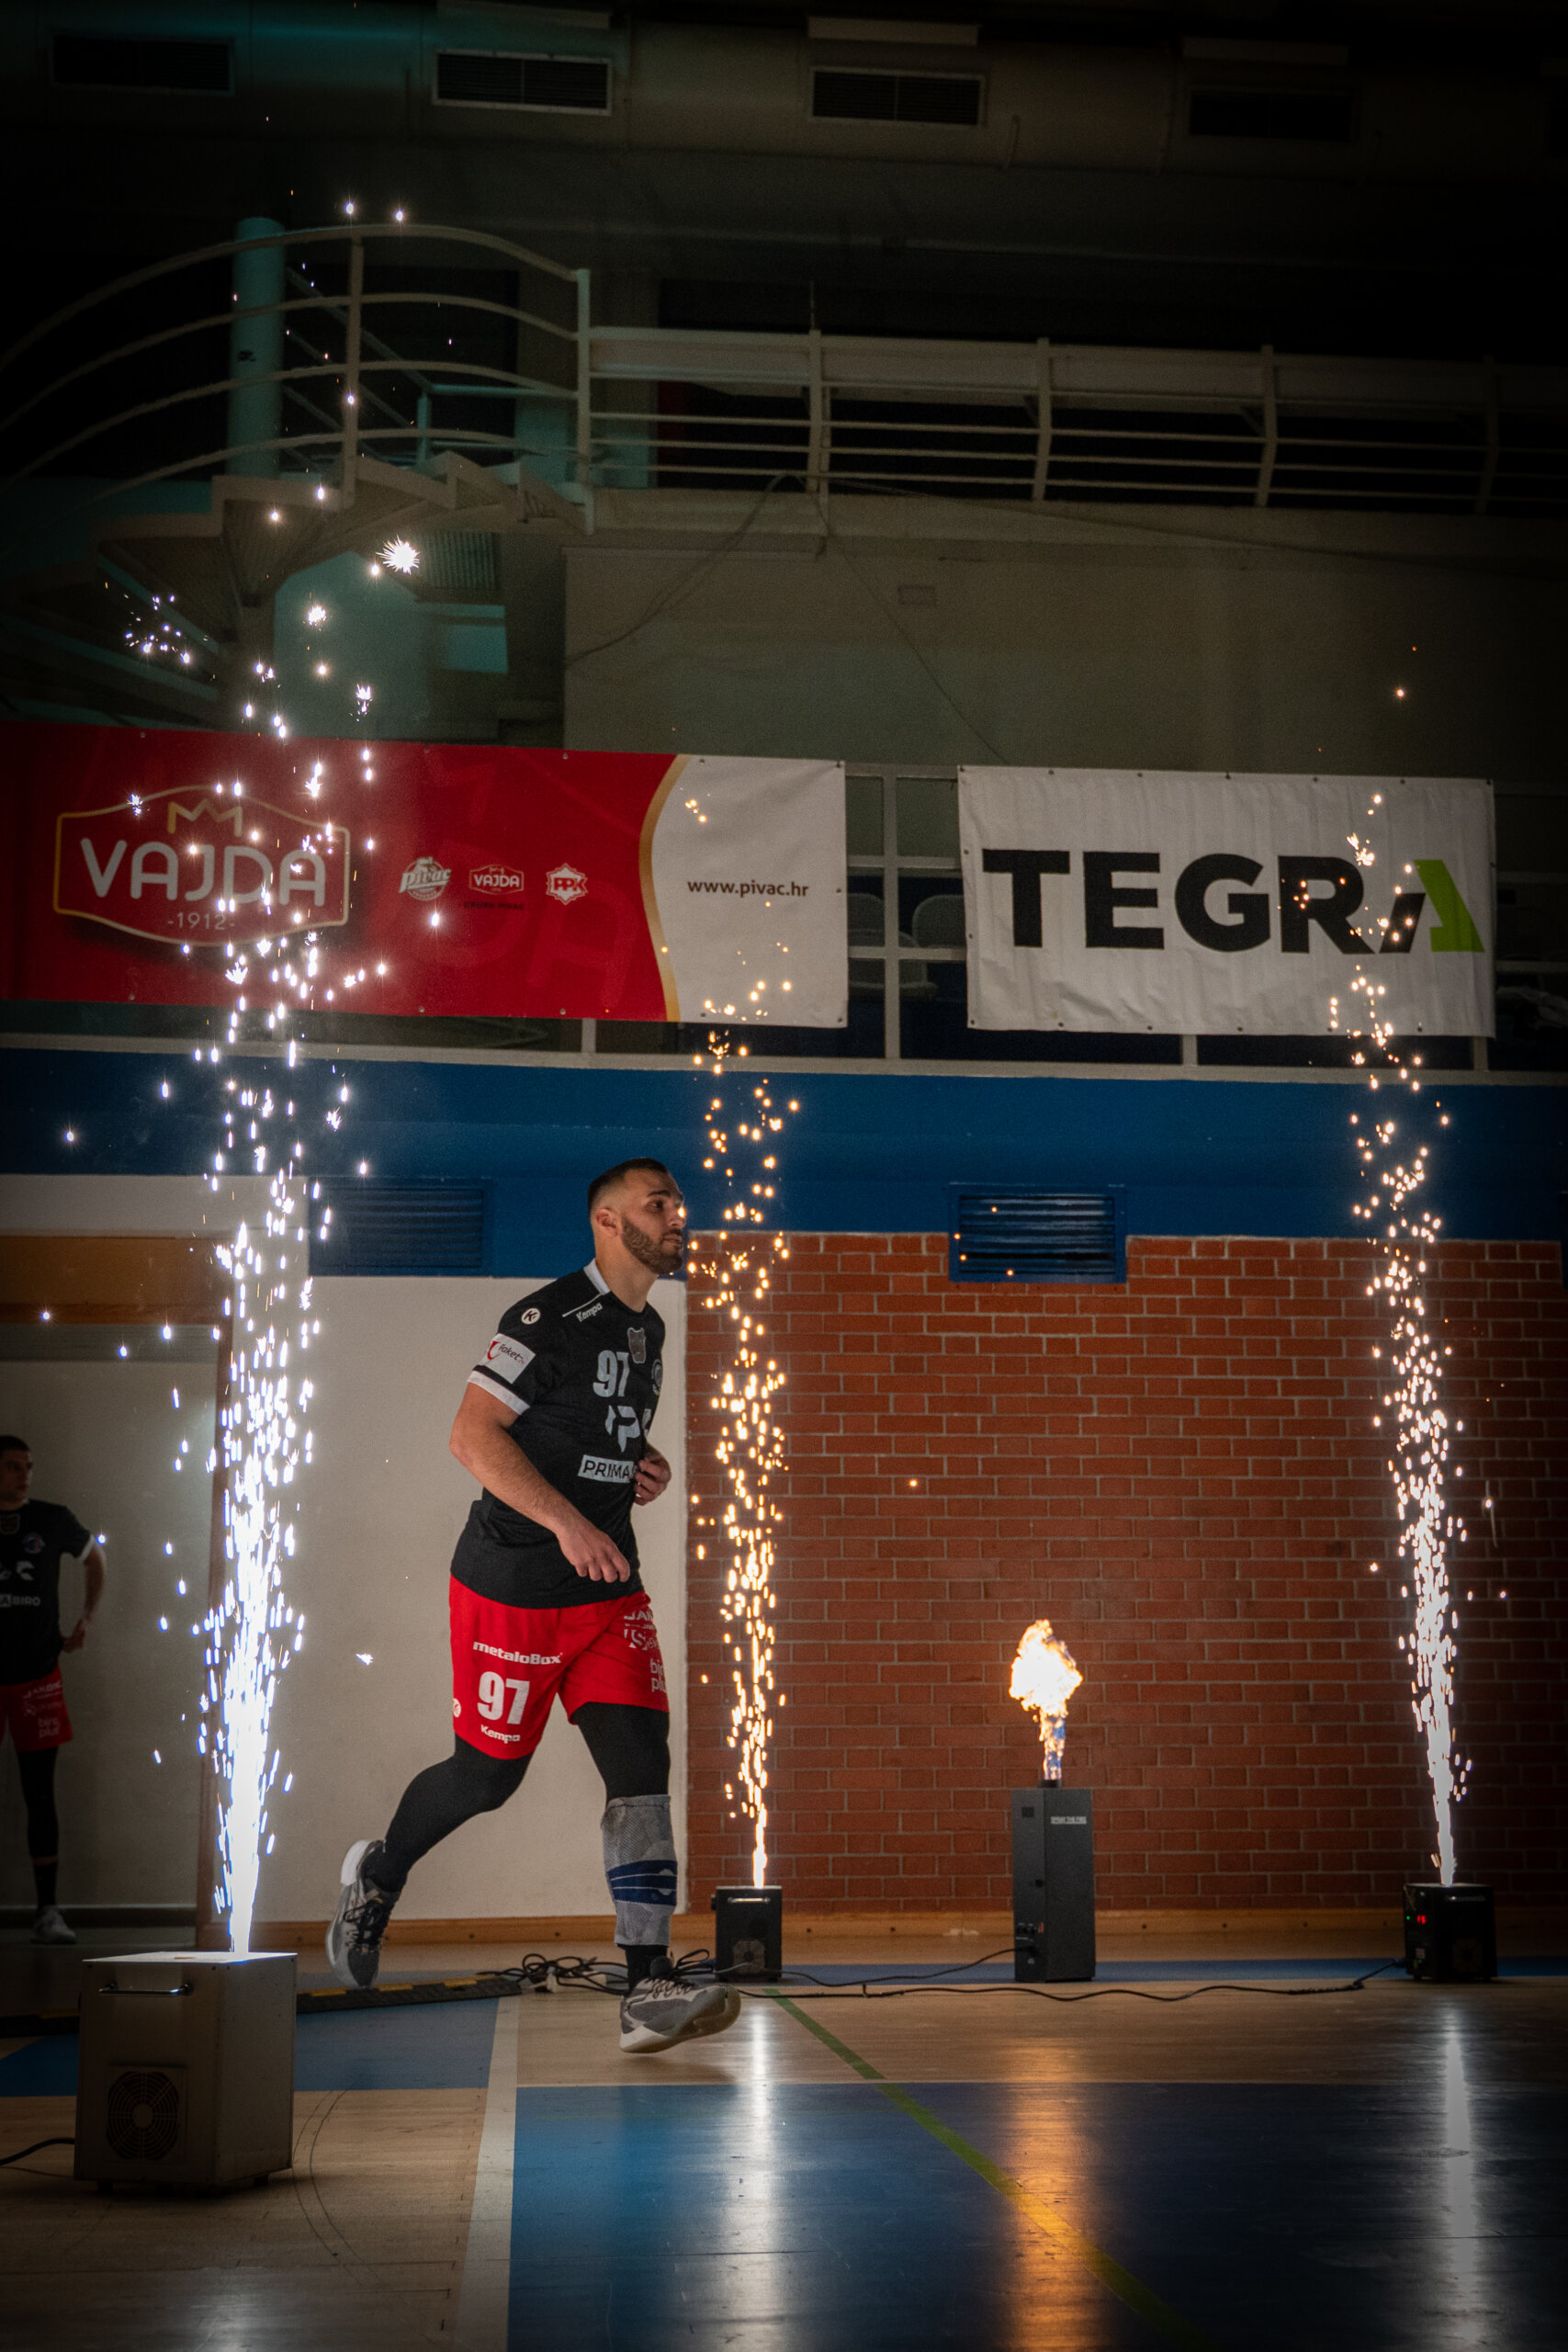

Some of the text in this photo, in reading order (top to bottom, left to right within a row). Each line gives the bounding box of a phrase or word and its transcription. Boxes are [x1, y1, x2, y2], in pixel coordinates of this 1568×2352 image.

[81, 838, 326, 907] VAJDA
[473, 874, 520, 888] VAJDA
[687, 879, 809, 898] www.pivac.hr
[981, 847, 1485, 956] TEGRA
[576, 1303, 603, 1322] Kempa
[592, 1350, 631, 1397] 97
[473, 1641, 562, 1665] metaloBox
[477, 1671, 530, 1724] 97
[480, 1724, 521, 1744] Kempa
